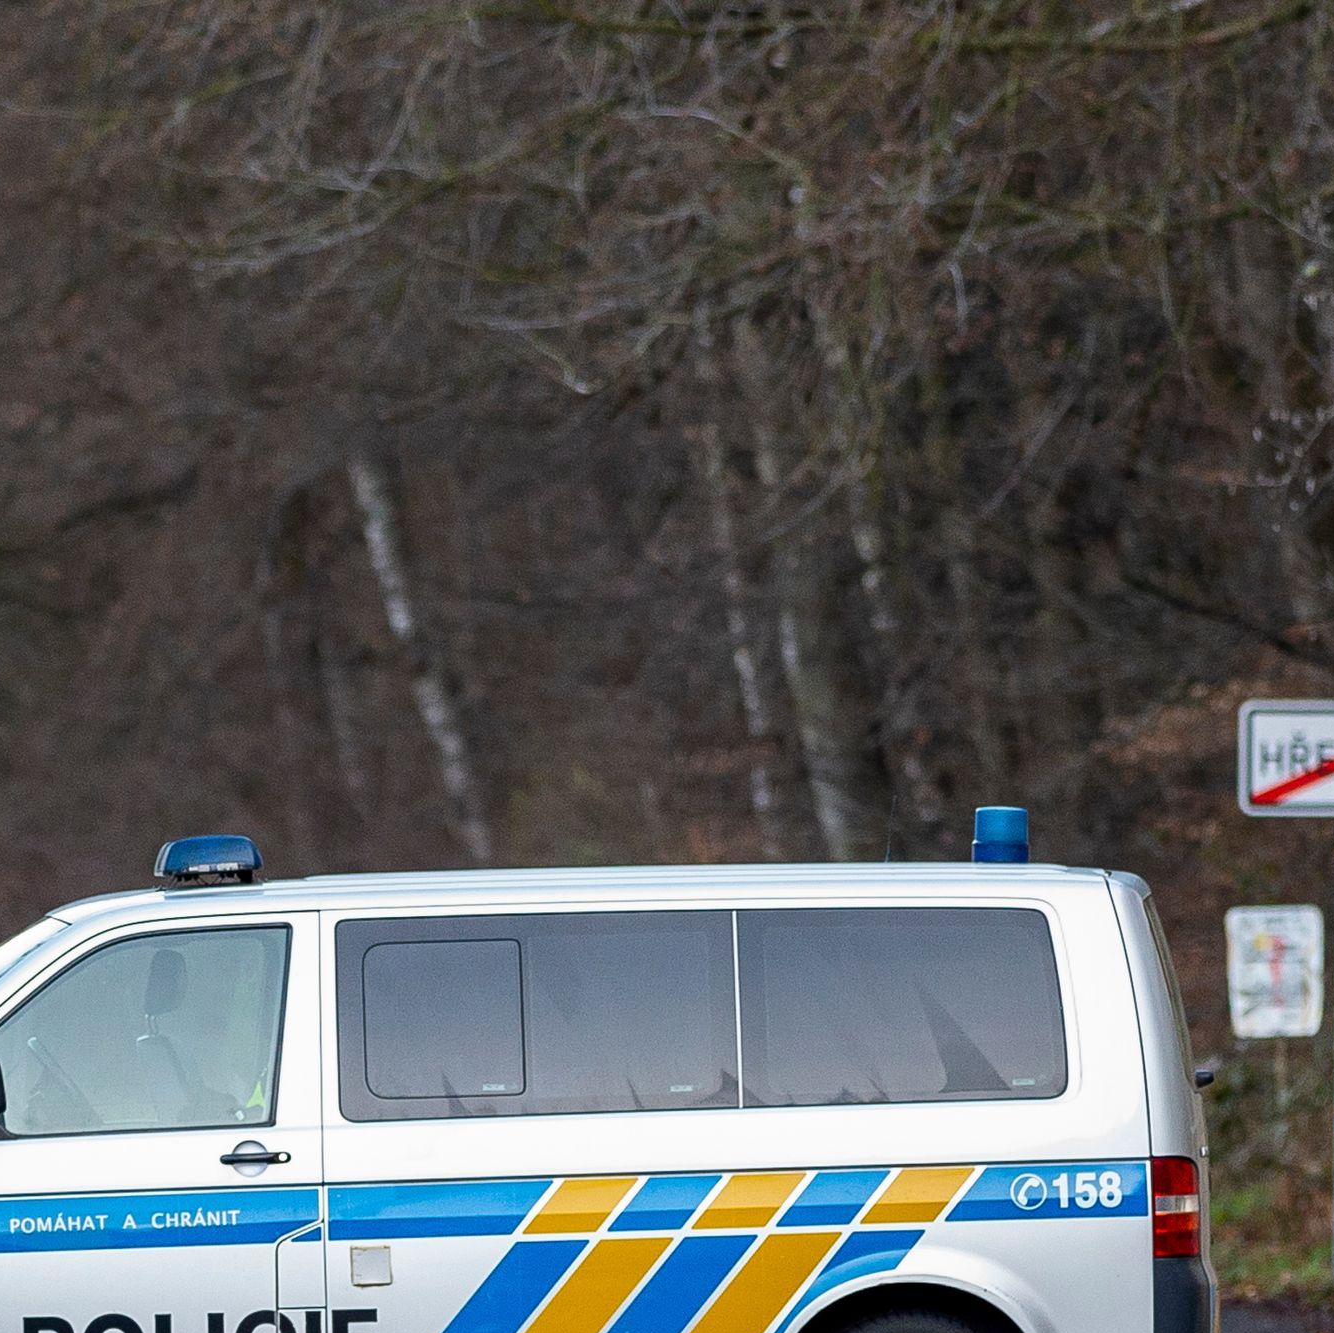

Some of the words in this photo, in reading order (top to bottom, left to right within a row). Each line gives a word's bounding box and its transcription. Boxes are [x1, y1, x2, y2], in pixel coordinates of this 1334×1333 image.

[1052, 1171, 1123, 1209] 158
[9, 1212, 109, 1234] POMÁHAT
[122, 1214, 137, 1230] A
[151, 1207, 241, 1229] CHRÁNIT
